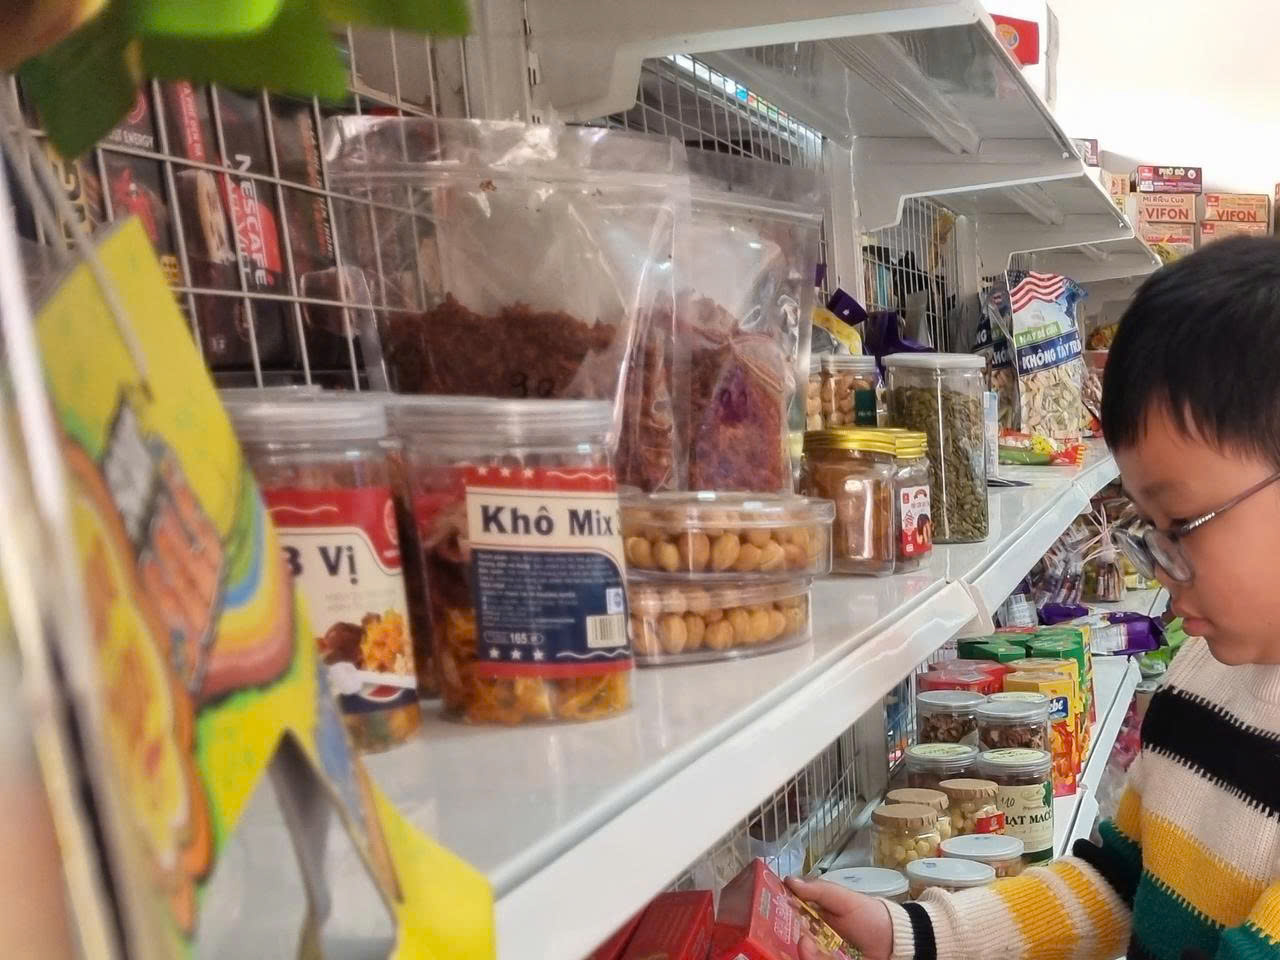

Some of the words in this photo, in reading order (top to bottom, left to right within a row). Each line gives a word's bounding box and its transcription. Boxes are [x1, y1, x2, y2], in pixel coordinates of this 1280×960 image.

[1146, 207, 1189, 220] VIFON
[1216, 209, 1257, 221] VIFON
[1022, 346, 1056, 370] KHÔNG
[480, 504, 555, 537] Khô
[567, 508, 614, 537] Mix
[317, 544, 358, 585] Vị
